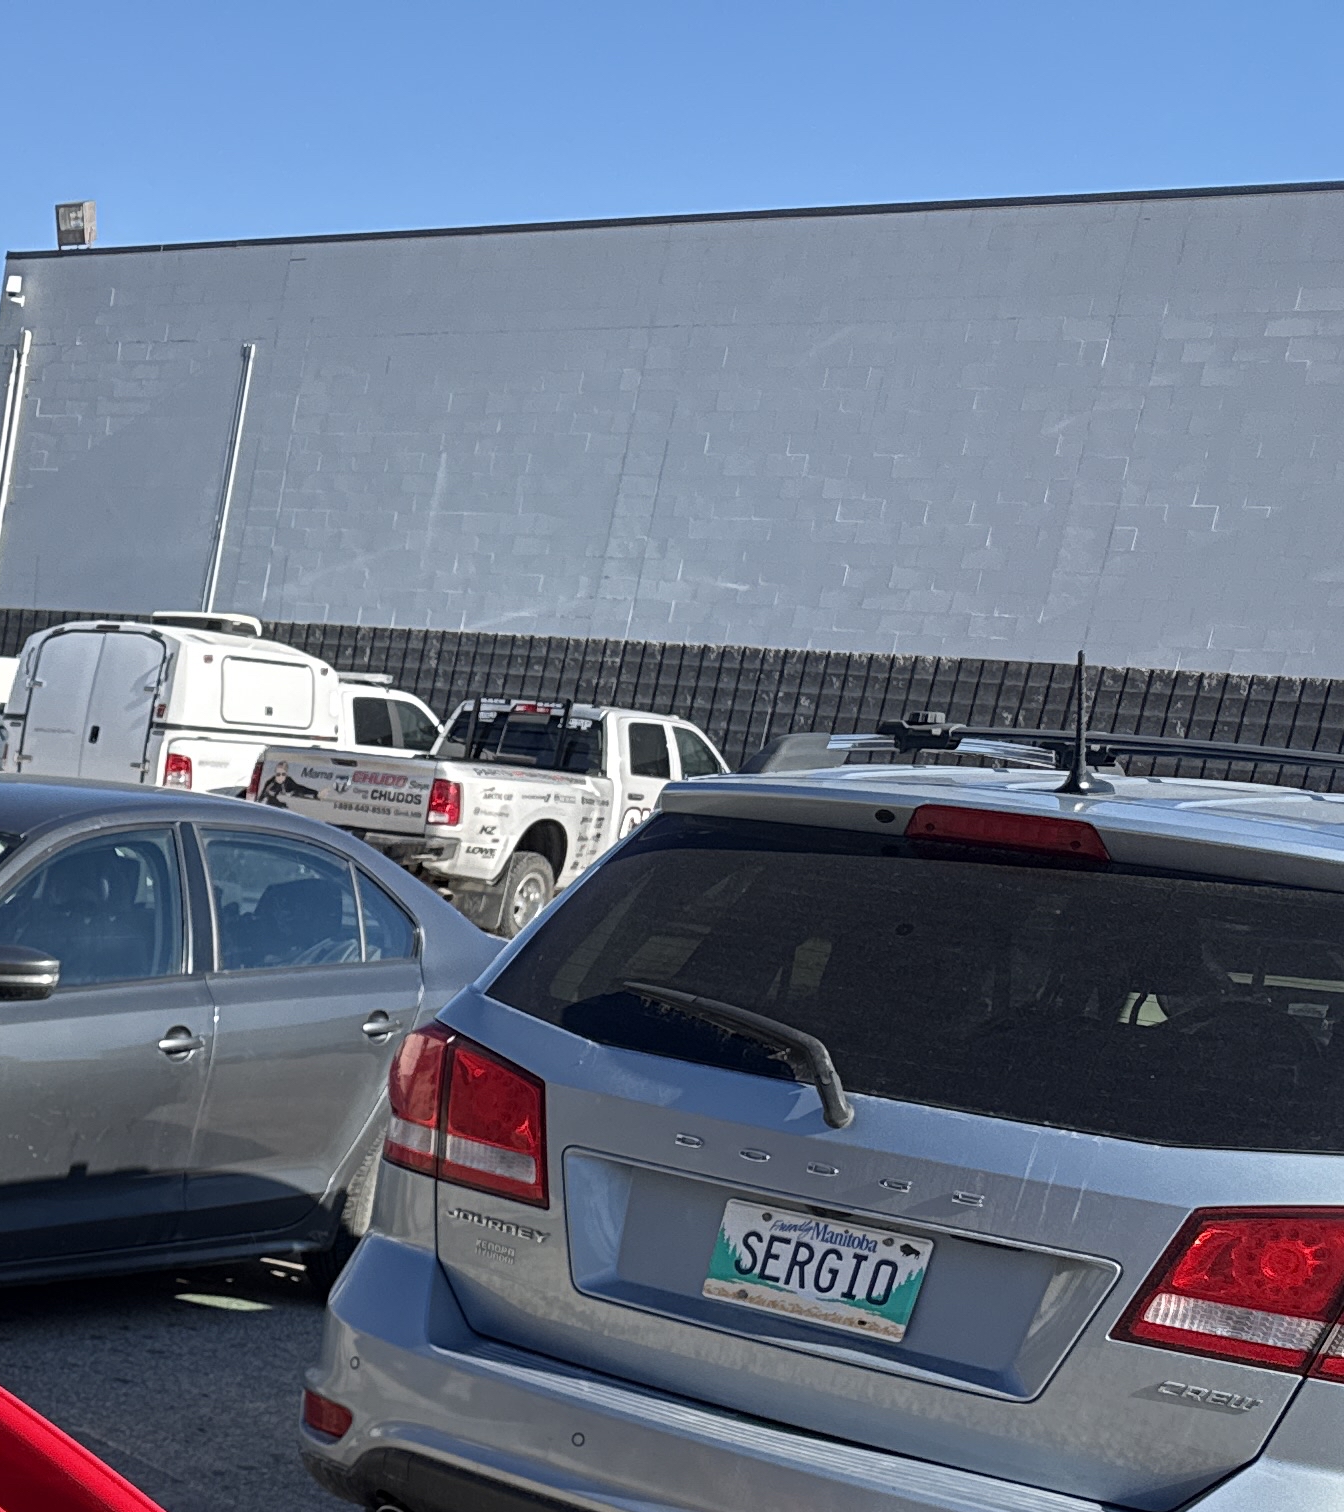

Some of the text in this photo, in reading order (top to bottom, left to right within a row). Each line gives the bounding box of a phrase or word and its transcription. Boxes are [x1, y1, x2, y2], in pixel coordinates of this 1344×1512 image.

[675, 1133, 985, 1207] DODGE
[447, 1207, 551, 1243] JOURNEY
[769, 1219, 878, 1254] Friendly Manitoba
[734, 1231, 898, 1305] SERGIO
[1157, 1380, 1264, 1410] CREW
